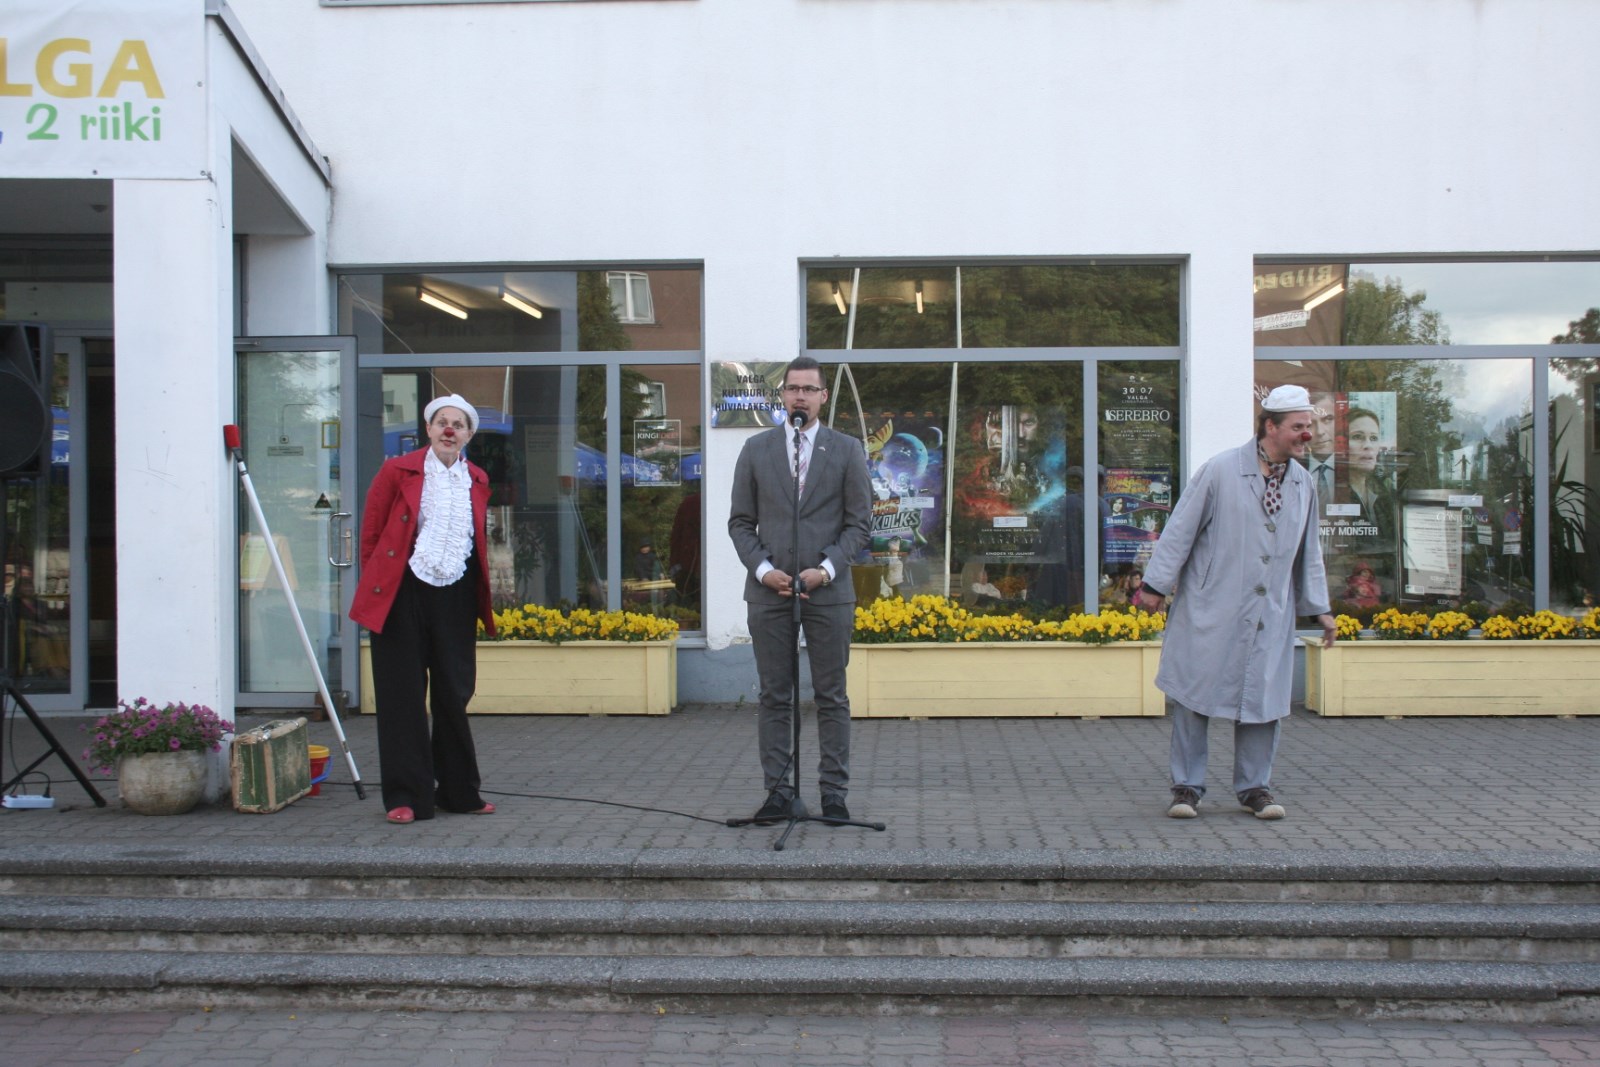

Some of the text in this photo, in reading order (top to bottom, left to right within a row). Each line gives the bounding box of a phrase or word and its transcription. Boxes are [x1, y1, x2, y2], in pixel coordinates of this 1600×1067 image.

[26, 102, 161, 141] 2 riiki
[737, 375, 765, 384] VALGA
[1110, 409, 1170, 421] SEREBRO
[871, 511, 919, 530] KOLKS
[1319, 526, 1378, 536] NEY MONSTER
